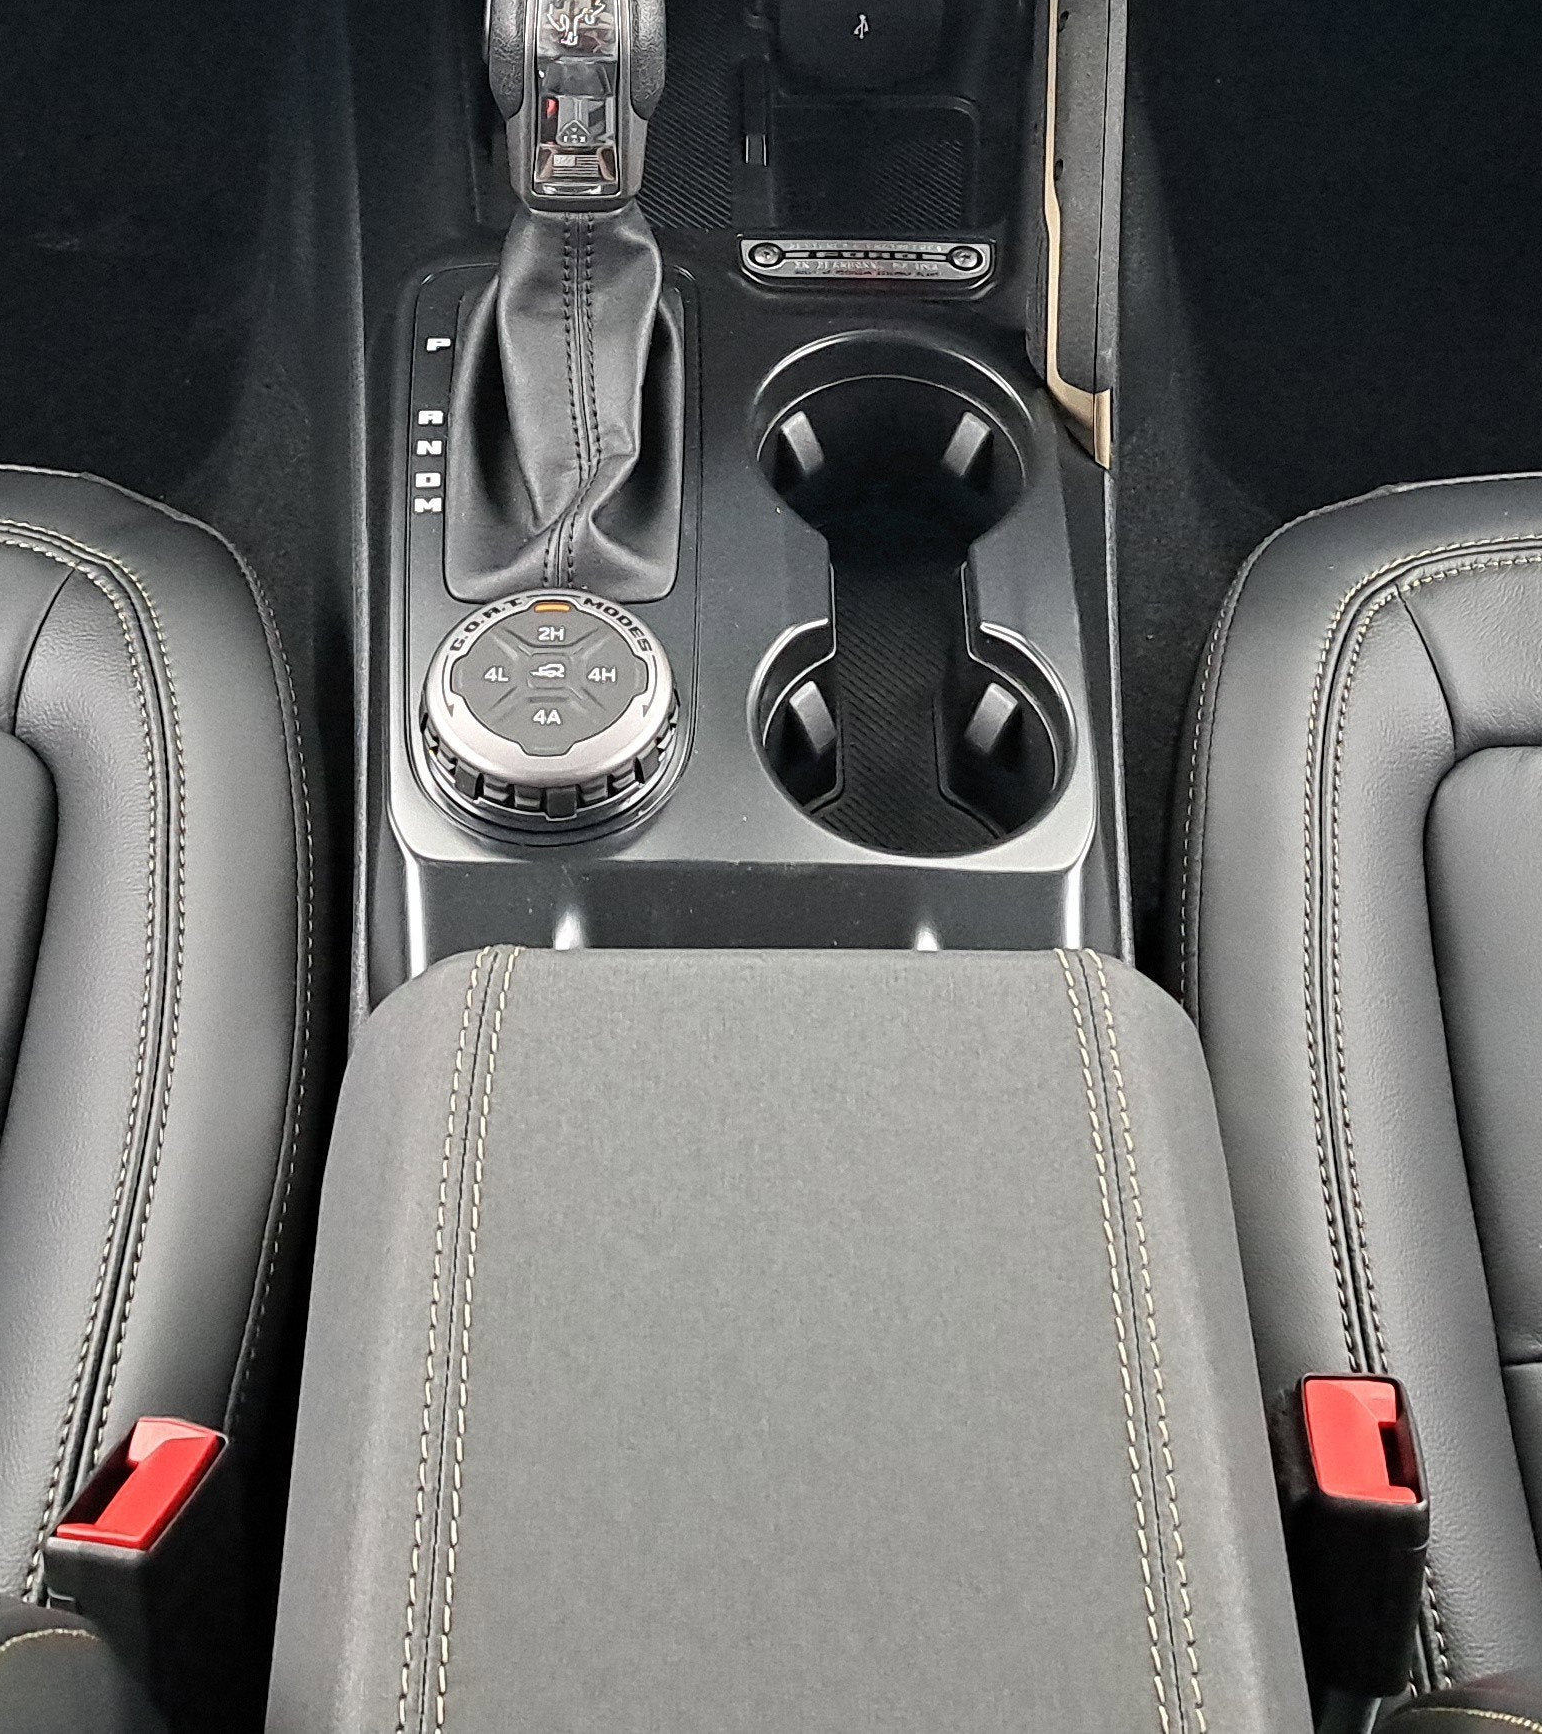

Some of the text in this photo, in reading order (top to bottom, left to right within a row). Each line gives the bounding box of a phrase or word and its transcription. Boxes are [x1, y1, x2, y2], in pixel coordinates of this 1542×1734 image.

[426, 337, 451, 352] P
[418, 410, 443, 425] R
[416, 440, 442, 456] N
[415, 473, 441, 488] D
[414, 498, 442, 513] M
[583, 597, 653, 652] MODES
[538, 627, 565, 642] 2H
[484, 667, 509, 682] 4L
[587, 666, 617, 683] 4H
[533, 709, 562, 726] 4A
